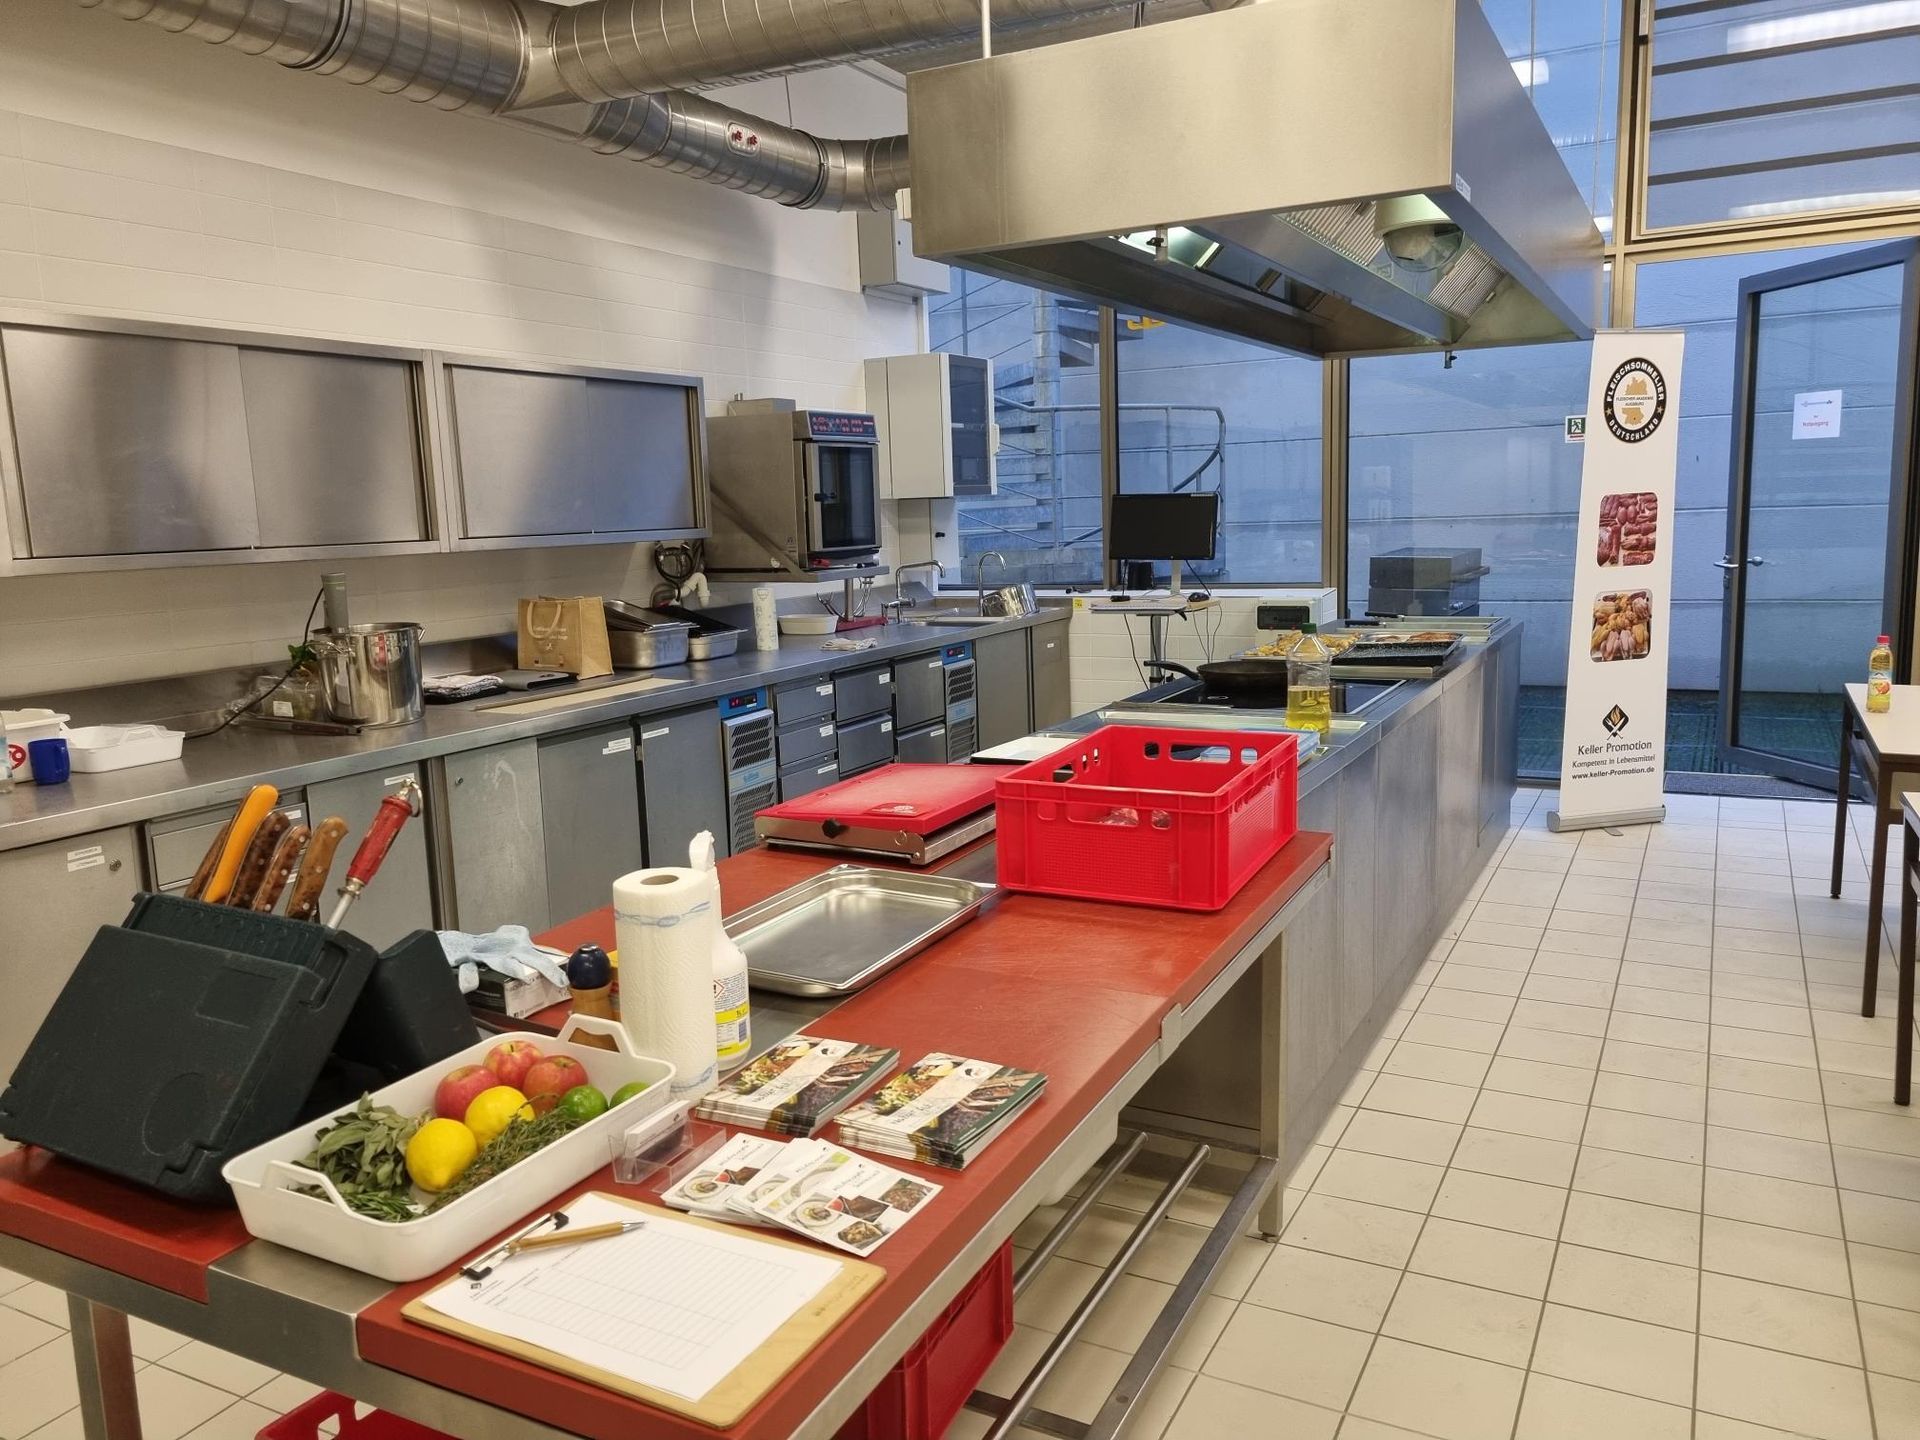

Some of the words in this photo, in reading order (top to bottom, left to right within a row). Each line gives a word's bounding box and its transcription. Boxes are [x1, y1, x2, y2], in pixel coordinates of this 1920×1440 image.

[1606, 361, 1664, 402] FLEISCHSOMMELIER
[1609, 418, 1659, 441] DEUTSCHLAND
[1577, 744, 1603, 755] Keller
[1606, 741, 1652, 753] Promotion
[1572, 760, 1607, 768] Kompetenz
[1616, 754, 1656, 764] Lebensmittel
[1572, 766, 1655, 780] www.keller-Promotion.de
